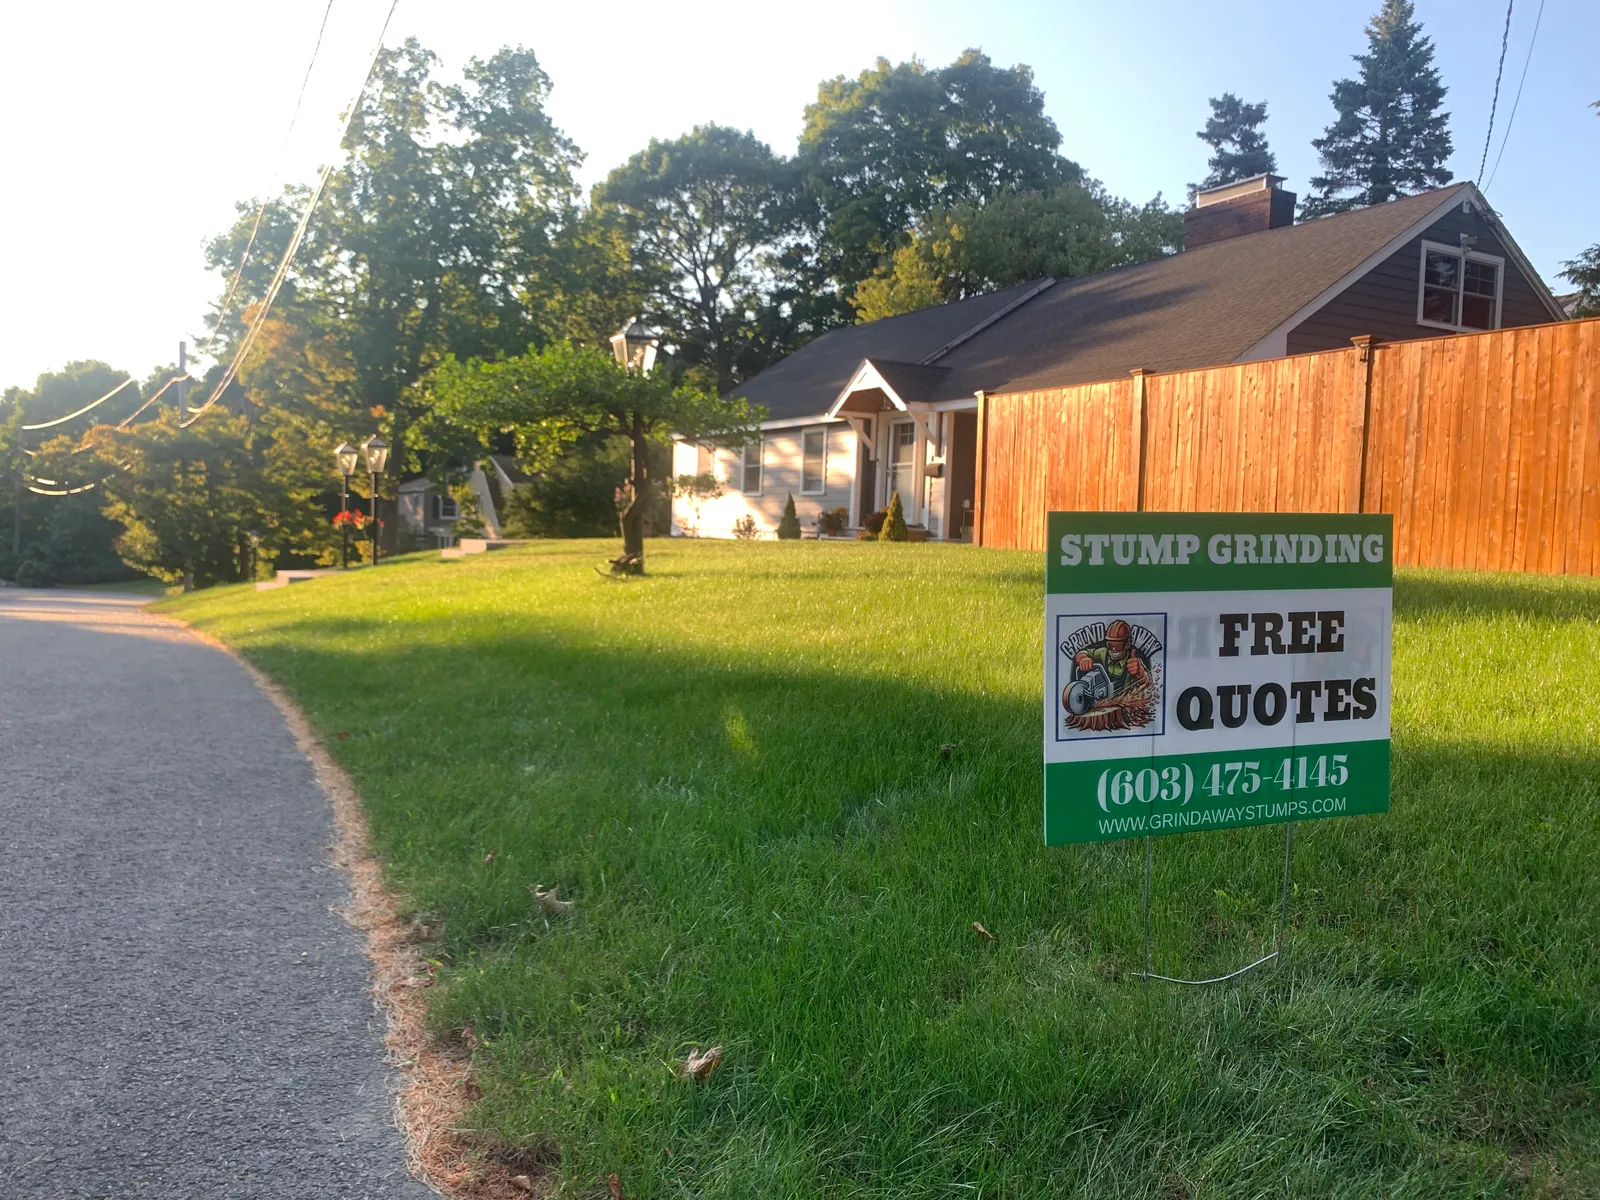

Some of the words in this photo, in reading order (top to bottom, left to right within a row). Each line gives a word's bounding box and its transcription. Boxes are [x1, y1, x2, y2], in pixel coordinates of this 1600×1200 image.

[1060, 533, 1200, 566] STUMP
[1207, 533, 1384, 565] GRINDING
[1060, 621, 1105, 660] GRIND
[1131, 624, 1163, 658] AWAY
[1218, 610, 1345, 657] FREE
[1176, 677, 1377, 731] QUOTES
[1097, 762, 1194, 813] (603)
[1201, 753, 1349, 797] 475-4145
[1098, 797, 1347, 835] WWW.GRINDAWAYSTUMPS.COM
